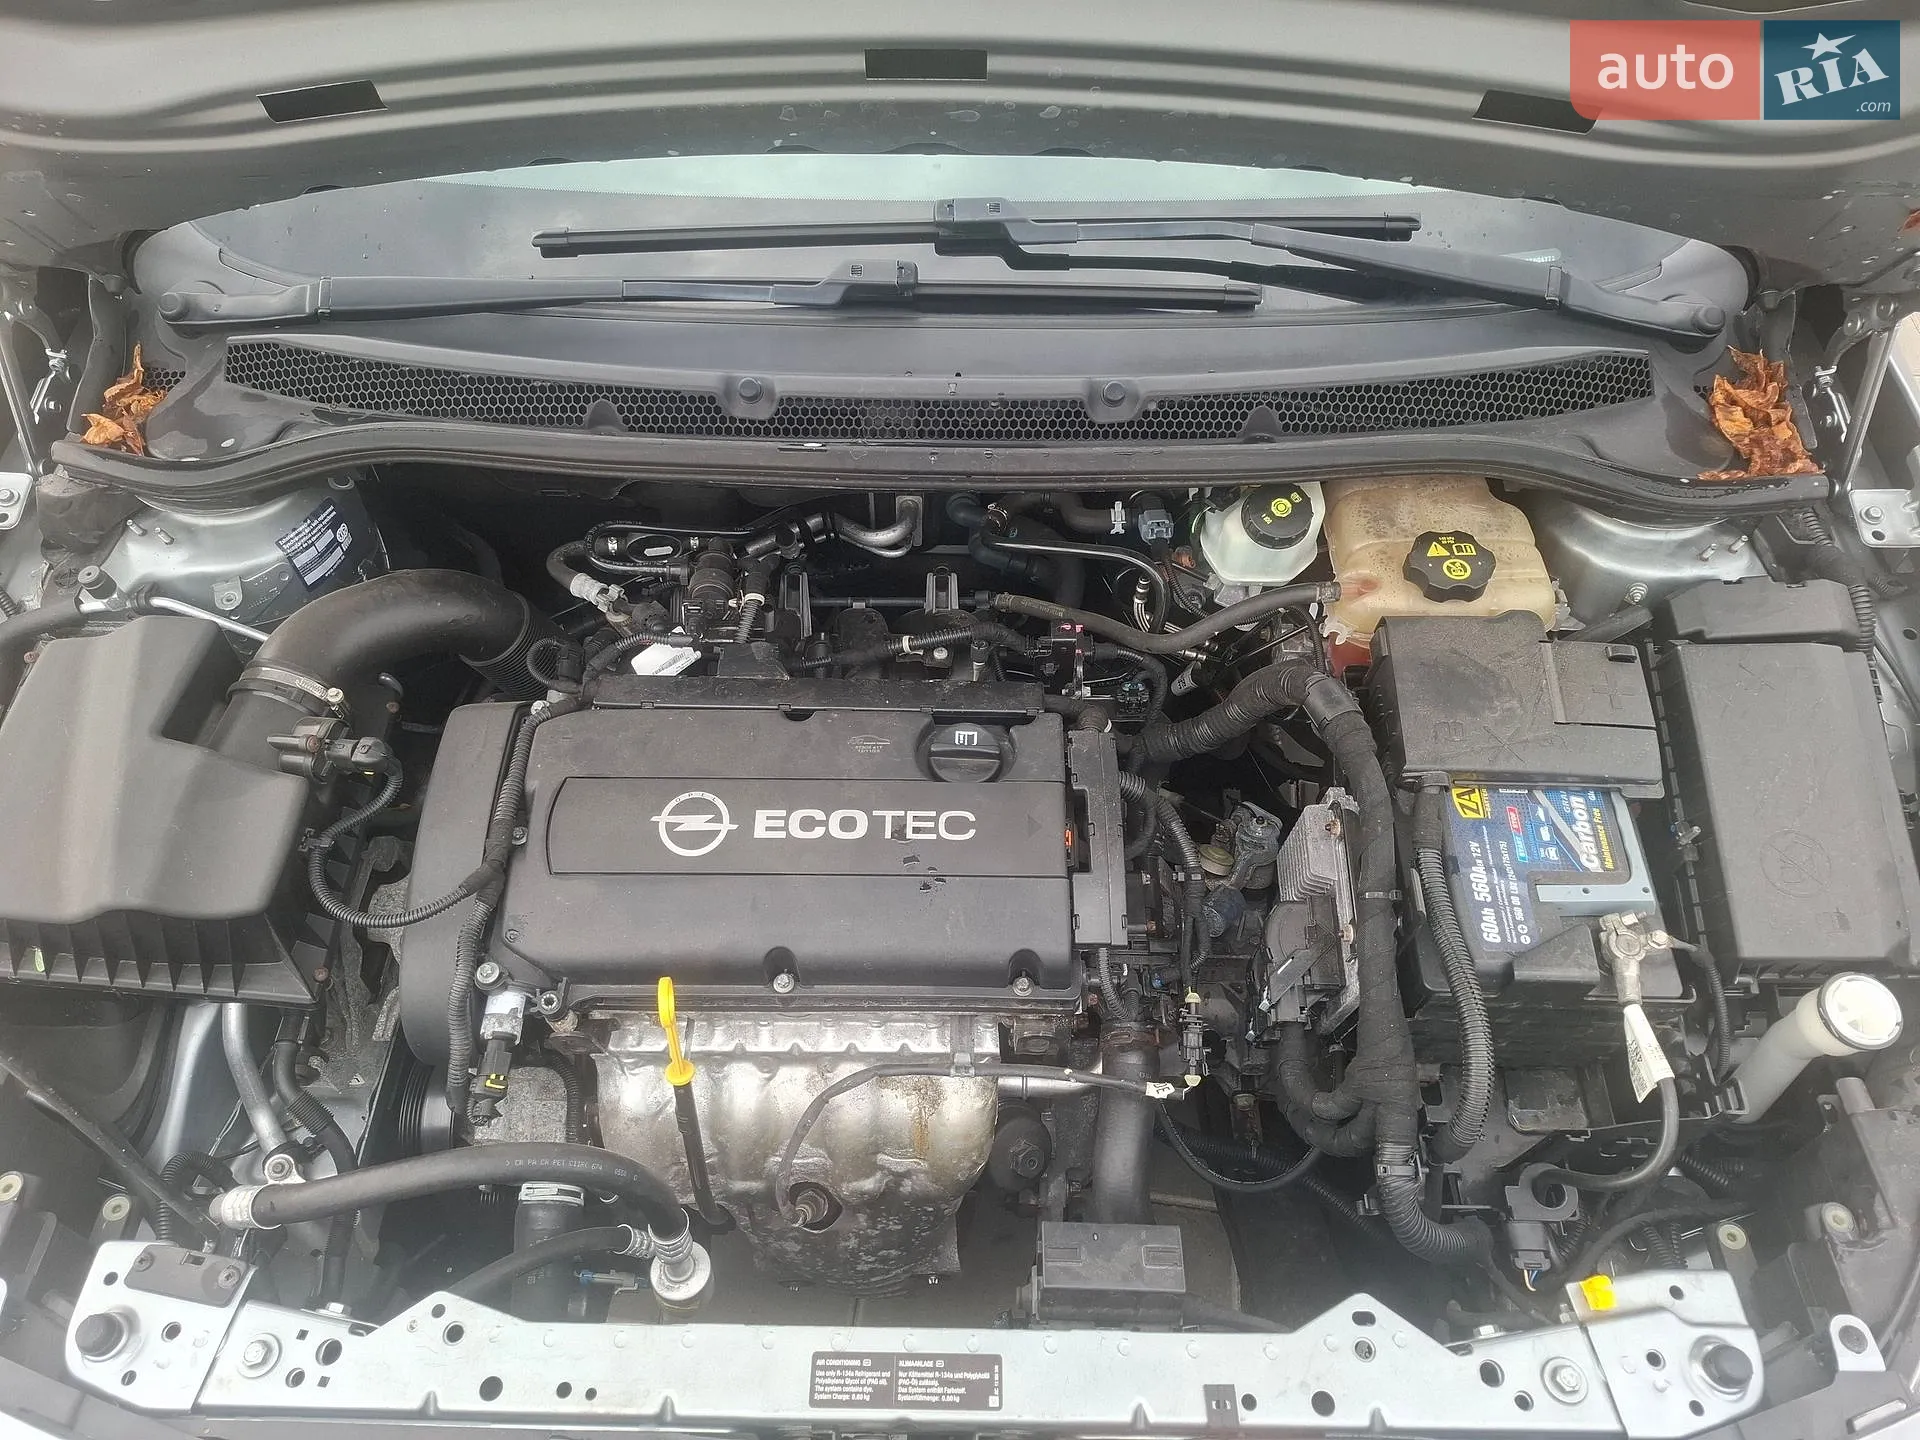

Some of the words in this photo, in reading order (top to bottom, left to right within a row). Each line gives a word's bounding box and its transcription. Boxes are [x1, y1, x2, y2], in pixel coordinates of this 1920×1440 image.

[753, 808, 977, 841] ECOTEC
[1569, 796, 1600, 869] Carbon
[1469, 841, 1482, 858] 12V
[1597, 824, 1614, 869] Maintenance
[1481, 908, 1501, 943] 60Ah
